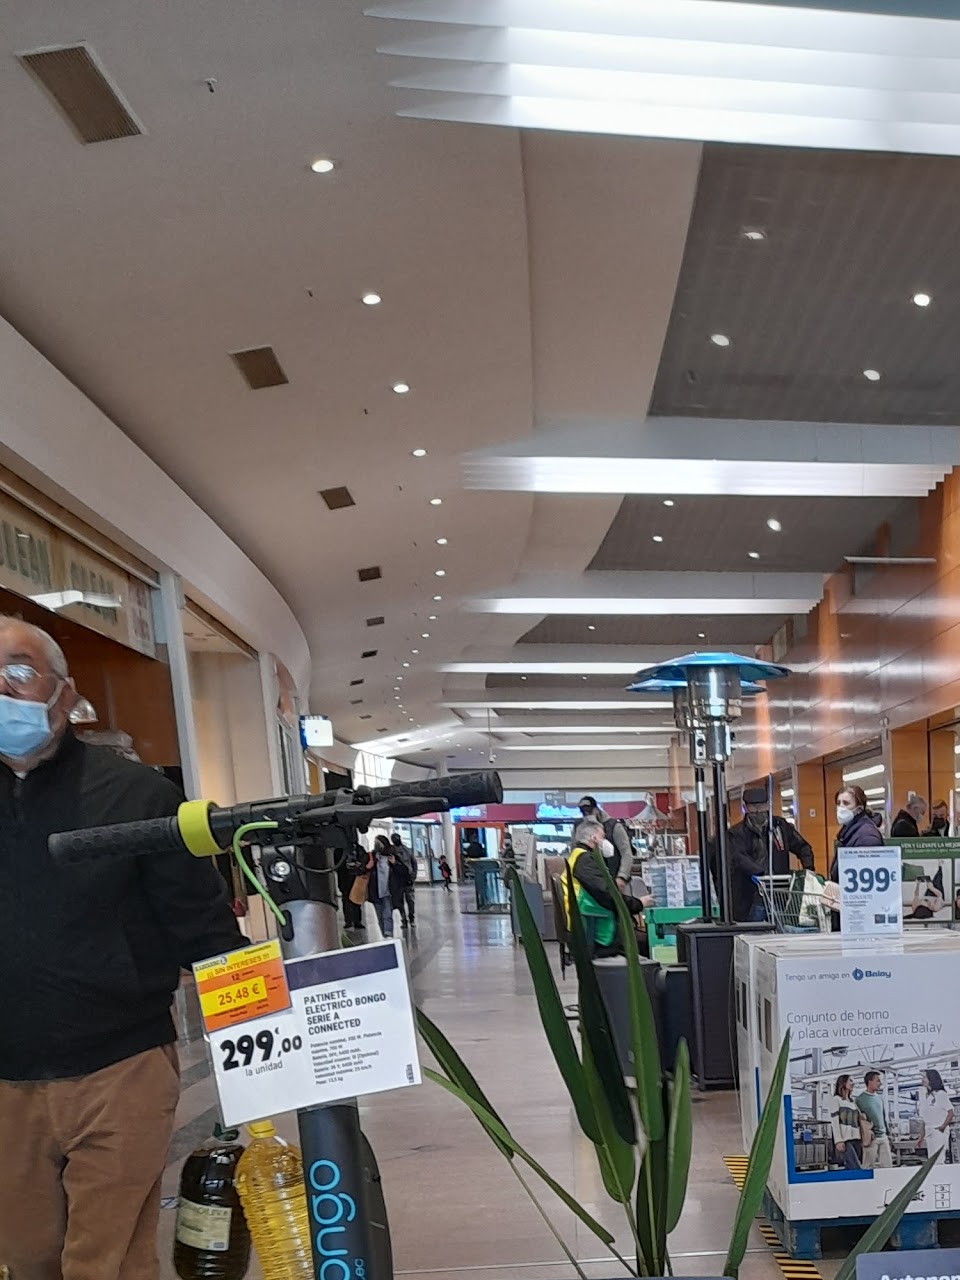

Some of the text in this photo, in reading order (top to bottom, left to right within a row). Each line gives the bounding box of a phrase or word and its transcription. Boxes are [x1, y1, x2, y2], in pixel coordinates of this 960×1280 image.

[215, 966, 226, 975] SIN
[226, 955, 262, 972] INTERESES
[231, 973, 240, 981] 12
[785, 973, 806, 982] Tengo
[818, 972, 840, 980] amigo
[865, 970, 892, 978] Balay
[218, 987, 249, 1006] 25,48
[303, 989, 347, 1005] PATINETE
[305, 992, 387, 1015] ELECTRICO BONGO
[307, 1012, 340, 1025] SERIE A
[787, 1009, 890, 1026] Conjunto de horno
[308, 1018, 361, 1036] CONNECTED
[798, 1028, 829, 1040] placa
[911, 1022, 942, 1035] Balay
[245, 1060, 283, 1077] la unidad
